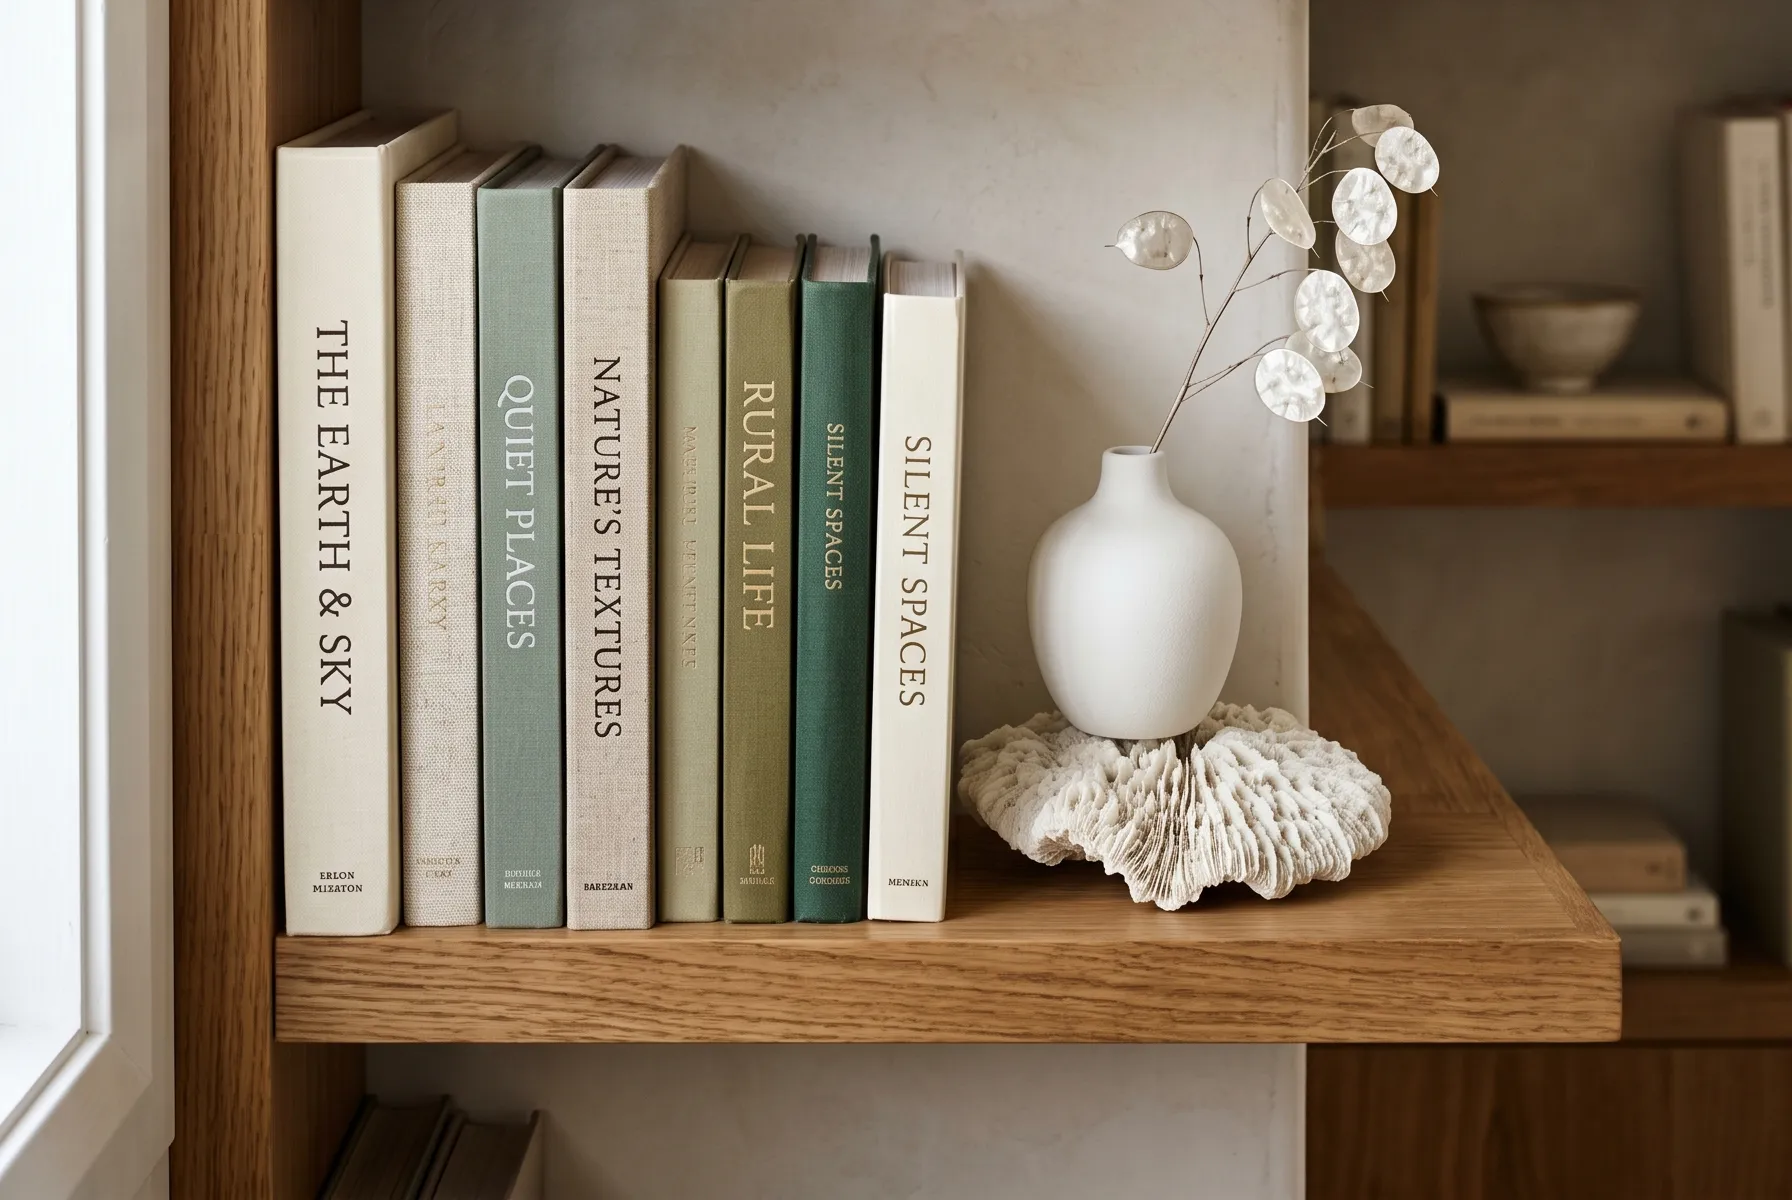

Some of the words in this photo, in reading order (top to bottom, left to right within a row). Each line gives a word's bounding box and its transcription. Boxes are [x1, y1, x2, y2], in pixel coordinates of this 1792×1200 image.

[316, 319, 349, 409] THE
[497, 374, 535, 496] QUIET
[593, 356, 622, 535] NATURE'S
[742, 380, 775, 526] RURAL
[826, 423, 845, 501] SILENT
[317, 424, 351, 572] EARTH
[824, 508, 844, 591] SPACES
[902, 436, 932, 565] SILENT
[318, 588, 352, 618] &
[505, 507, 536, 649] PLACES
[742, 541, 775, 631] LIFE
[318, 634, 352, 716] SKY
[593, 548, 622, 738] TEXTURES
[899, 577, 928, 707] SPACES
[319, 871, 355, 880] ERLON
